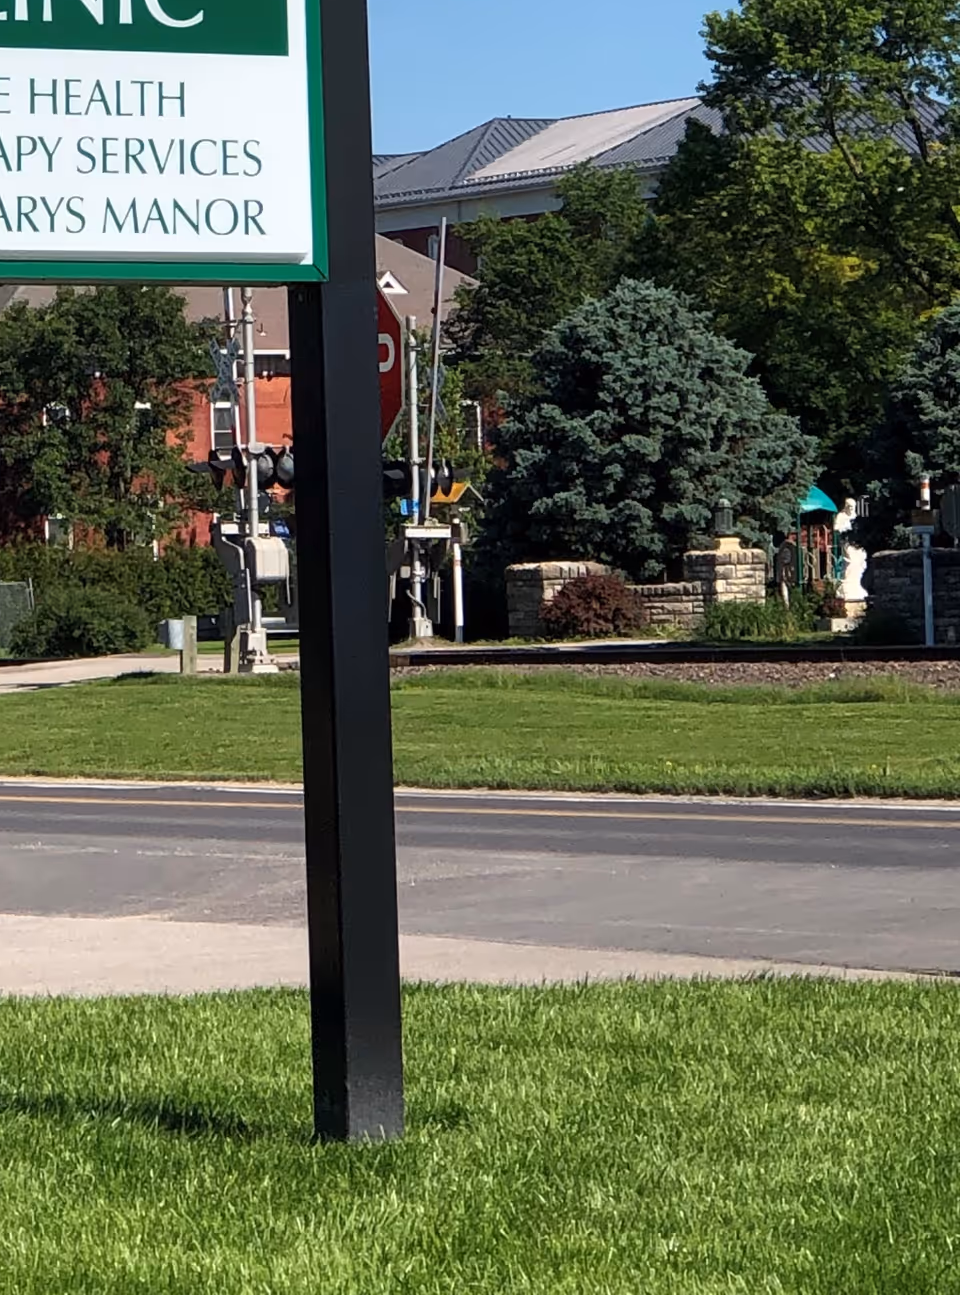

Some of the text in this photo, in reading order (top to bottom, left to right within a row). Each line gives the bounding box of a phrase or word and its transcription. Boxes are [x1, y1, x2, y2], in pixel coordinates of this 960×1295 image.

[29, 77, 186, 118] HEALTH
[76, 136, 262, 177] SERVICES
[102, 196, 266, 236] MANOR
